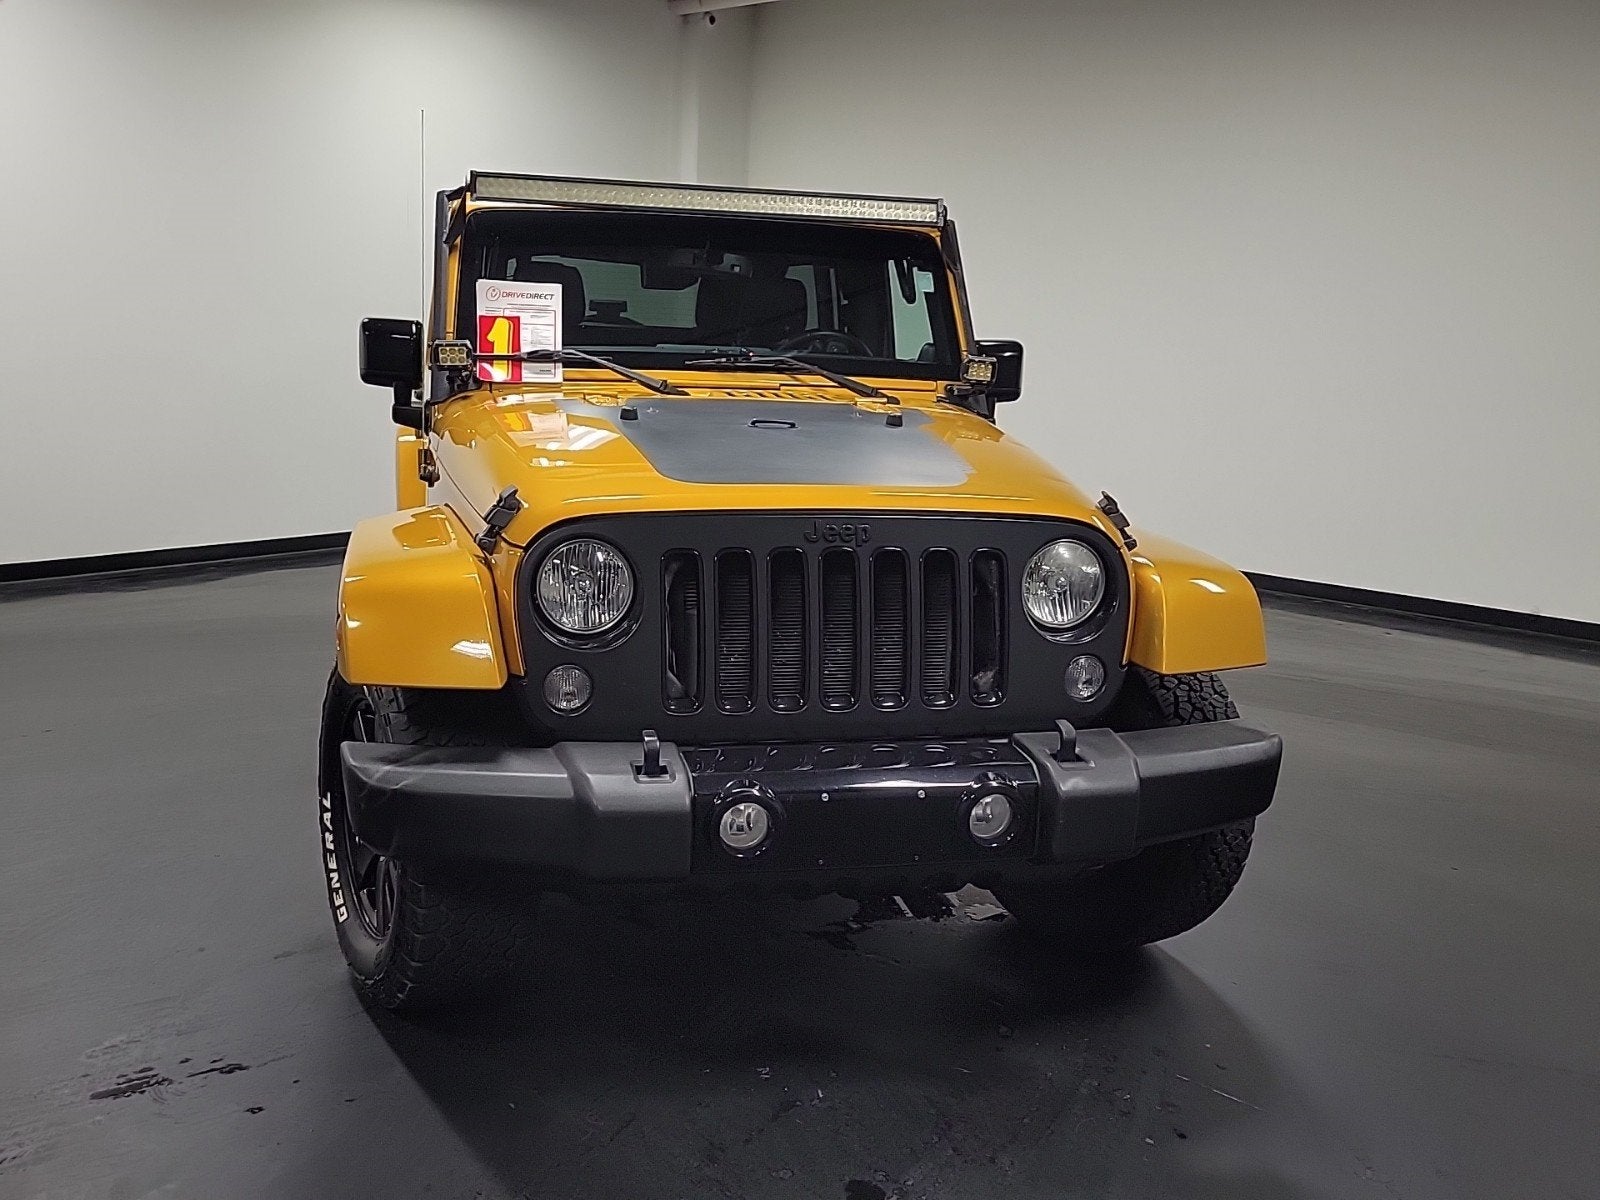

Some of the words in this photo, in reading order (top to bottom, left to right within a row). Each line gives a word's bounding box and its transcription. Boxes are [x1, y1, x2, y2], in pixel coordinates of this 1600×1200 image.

[501, 291, 555, 301] DRIVEDIRECT
[487, 317, 513, 381] 1
[804, 521, 870, 547] Jeep
[322, 791, 349, 923] GENERAL
